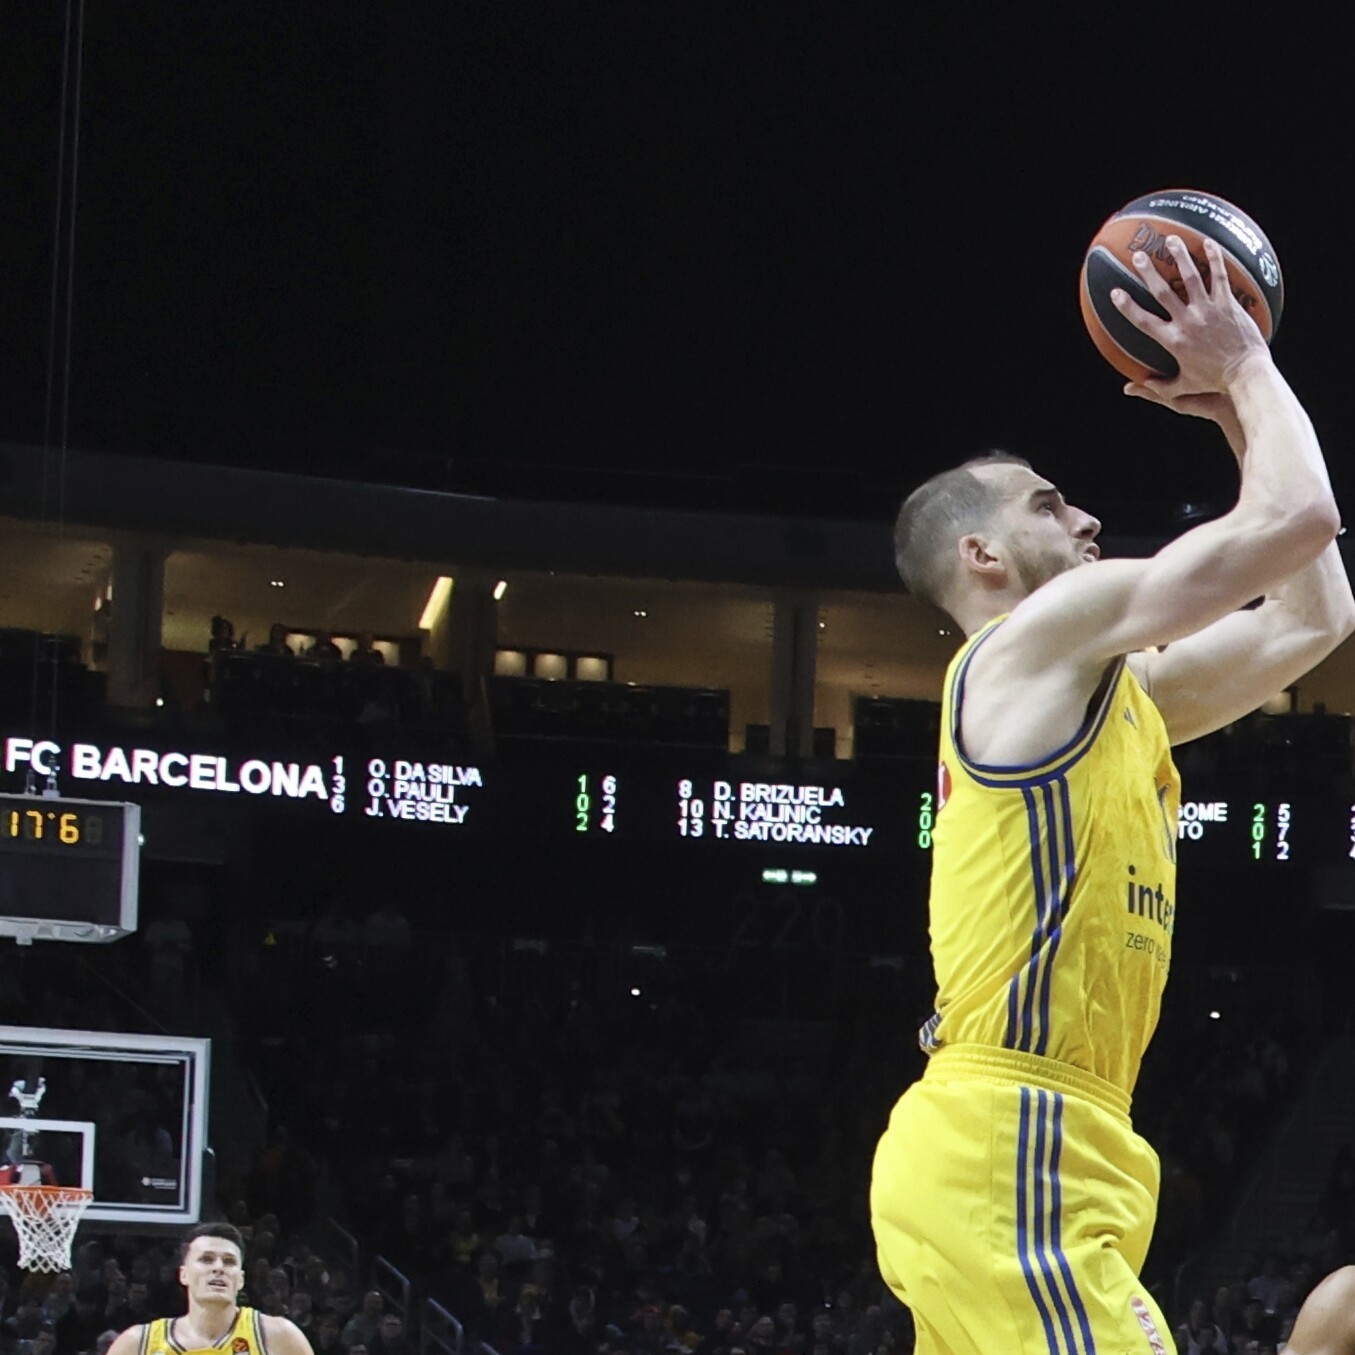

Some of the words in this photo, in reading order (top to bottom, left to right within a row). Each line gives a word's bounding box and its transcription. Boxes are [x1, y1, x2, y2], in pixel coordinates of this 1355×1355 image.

[5, 737, 61, 775] FC
[72, 743, 329, 800] BARCELONA
[332, 755, 344, 774] 1
[368, 758, 391, 779] O.
[428, 764, 483, 787] SILVA
[331, 775, 346, 793] 3
[367, 778, 390, 798] O.
[394, 780, 455, 803] PAULI
[578, 774, 587, 793] 1
[602, 775, 617, 794] 6
[678, 779, 693, 798] 8
[713, 781, 736, 801] D.
[740, 783, 845, 807] BRIZUELA
[330, 795, 345, 813] 6
[364, 798, 384, 817] J.
[387, 799, 470, 824] VESELY
[576, 793, 589, 812] 0
[602, 795, 616, 813] 2
[920, 792, 932, 811] 2
[678, 799, 704, 819] 10
[713, 800, 735, 820] N.
[739, 803, 822, 825] KALINIC
[920, 812, 932, 829] 0
[1253, 804, 1265, 822] 2
[1278, 804, 1290, 822] 5
[576, 812, 588, 831] 2
[601, 814, 615, 833] 4
[678, 818, 704, 837] 13
[711, 819, 730, 839] T.
[734, 821, 874, 846] SATORANSKY
[1252, 822, 1264, 841] 0
[1277, 823, 1290, 841] 7
[919, 830, 931, 849] 0
[1252, 841, 1261, 860] 1
[1277, 841, 1289, 860] 2
